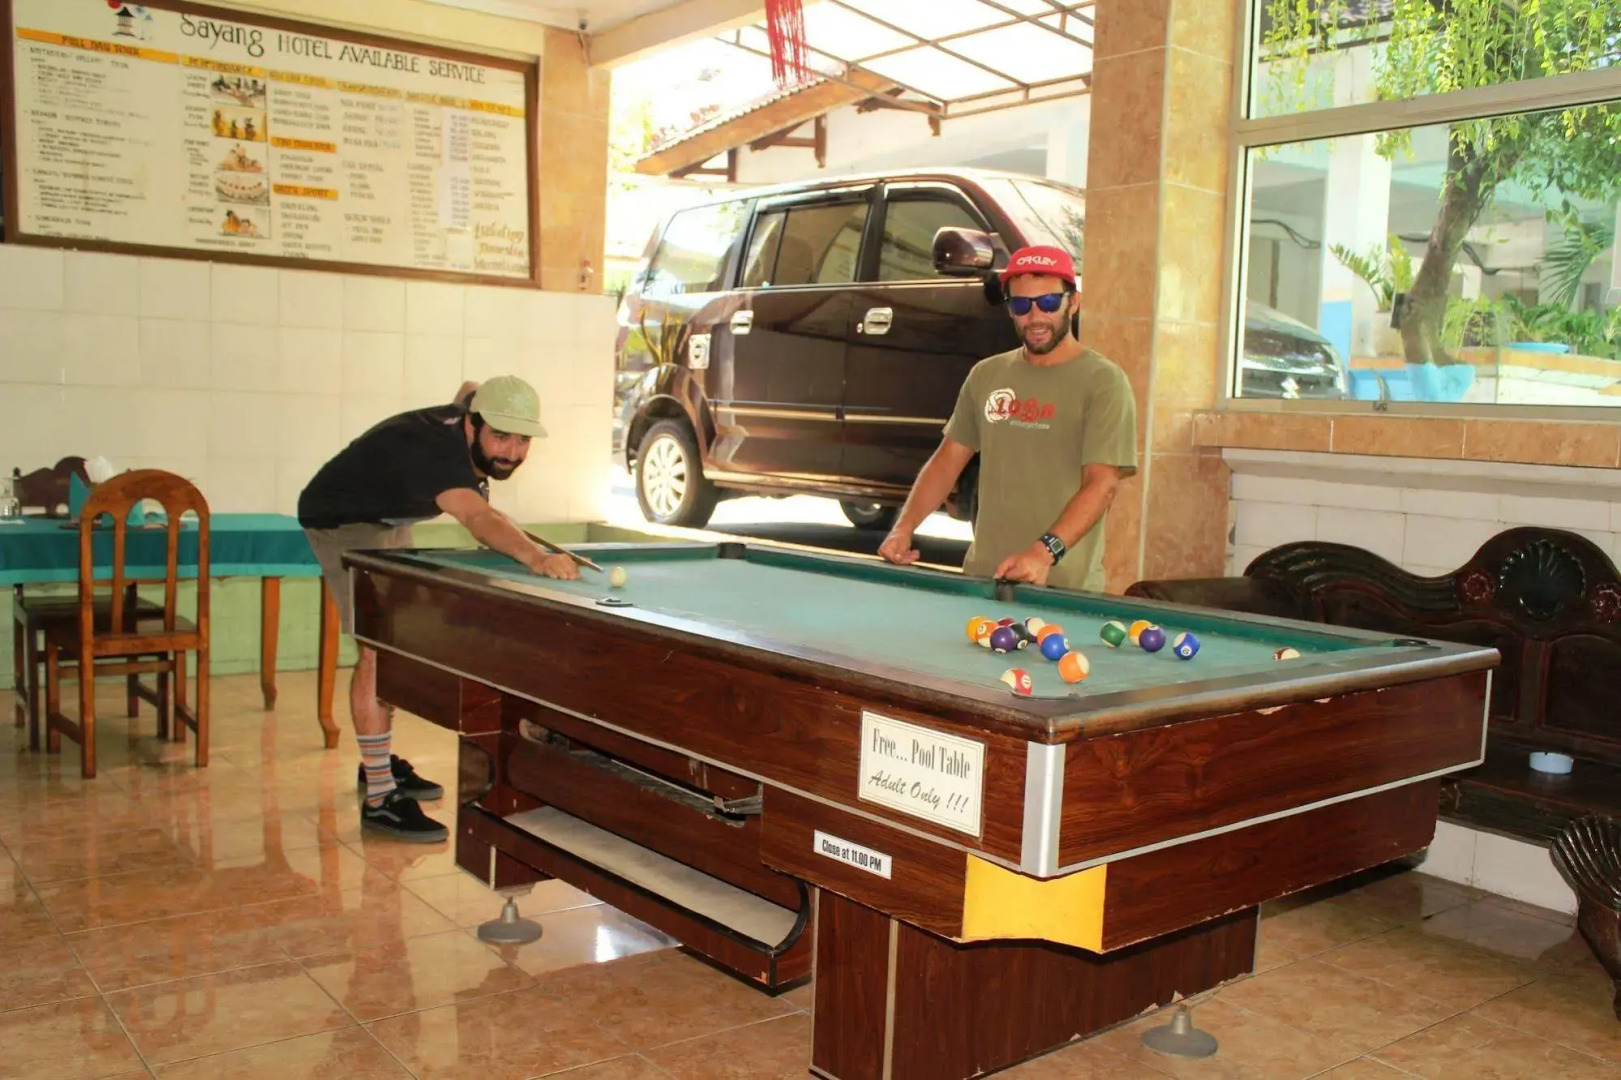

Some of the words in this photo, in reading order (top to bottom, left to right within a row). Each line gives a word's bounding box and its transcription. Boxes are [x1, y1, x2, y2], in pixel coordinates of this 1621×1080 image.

[180, 13, 264, 58] Sayang
[278, 34, 332, 60] HOTEL
[338, 45, 420, 73] AVAILABLE
[429, 61, 486, 84] SERVICE
[1016, 256, 1057, 266] OAKLEY
[872, 728, 908, 762] Free...
[911, 739, 935, 770] Pool
[939, 746, 971, 779] Table
[868, 770, 906, 795] Adult
[910, 781, 941, 810] Only
[946, 792, 969, 813] !!!
[822, 839, 840, 857] Close
[841, 848, 849, 860] at
[851, 849, 868, 867] 11.00
[870, 855, 882, 871] PM
